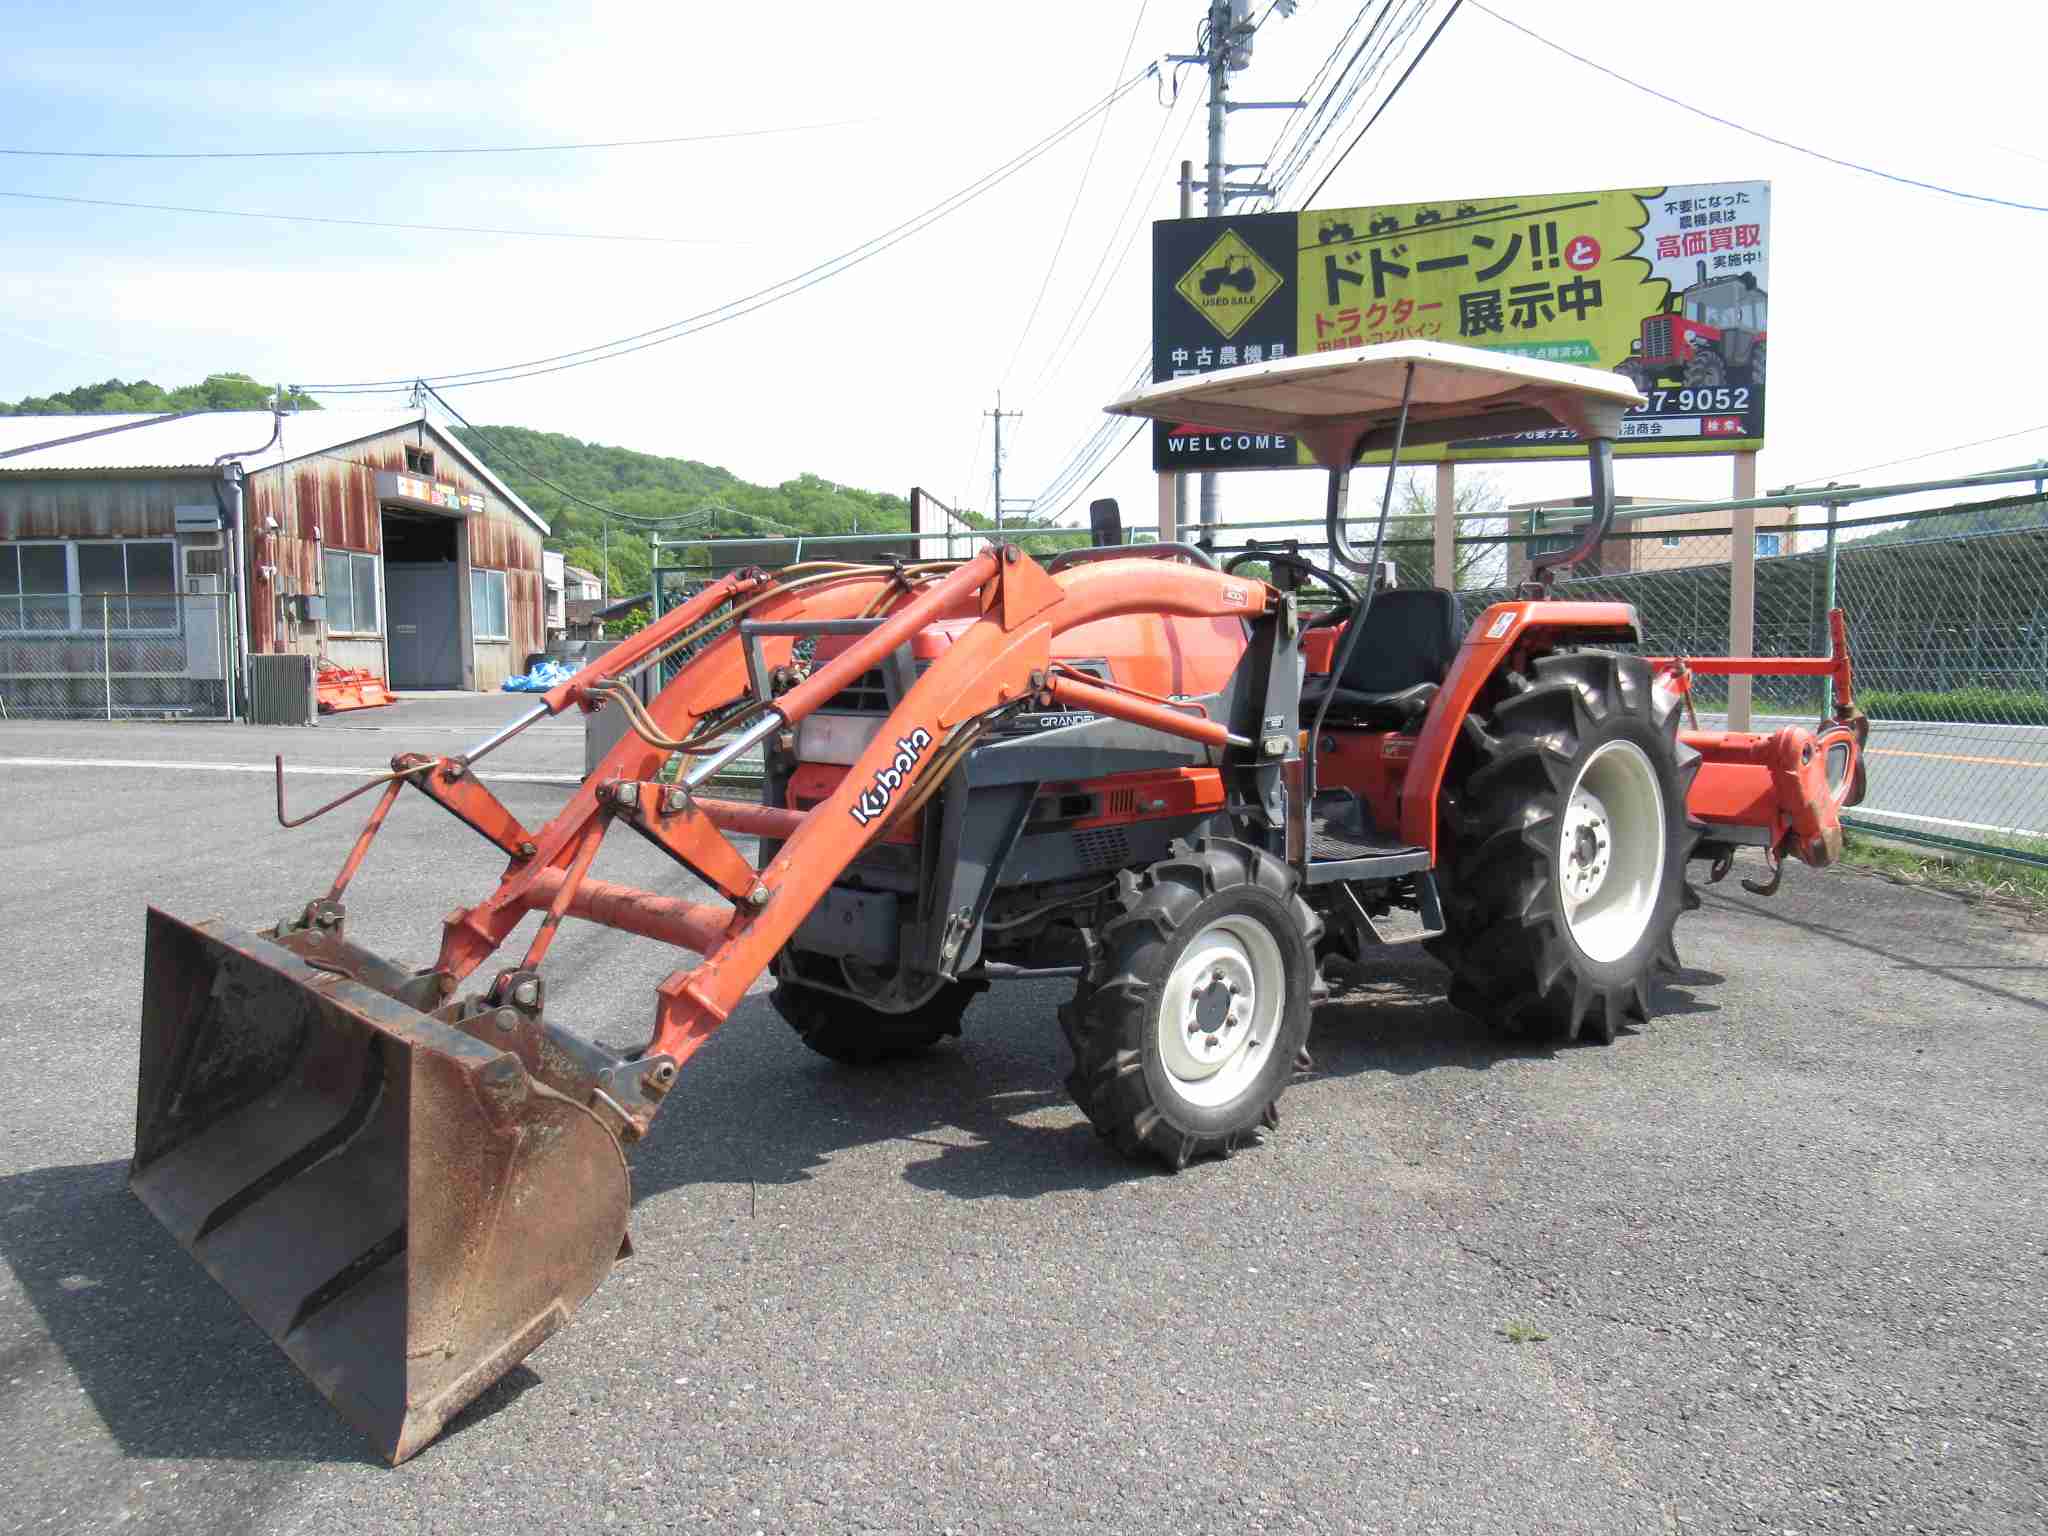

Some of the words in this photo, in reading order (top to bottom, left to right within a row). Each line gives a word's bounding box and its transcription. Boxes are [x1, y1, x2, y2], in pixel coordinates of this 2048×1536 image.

[1664, 191, 1750, 215] 不要になった
[1656, 223, 1760, 261] 高価買取
[1202, 297, 1229, 306] USED
[1231, 296, 1256, 305] SALE
[1458, 275, 1602, 337] 展示中
[1315, 299, 1442, 338] トラクター
[1171, 343, 1288, 367] 中古農機具
[1624, 387, 1749, 414] 57-9052
[1617, 422, 1663, 437] 治商会
[1168, 435, 1286, 452] WELCOME
[849, 728, 932, 825] Kubota
